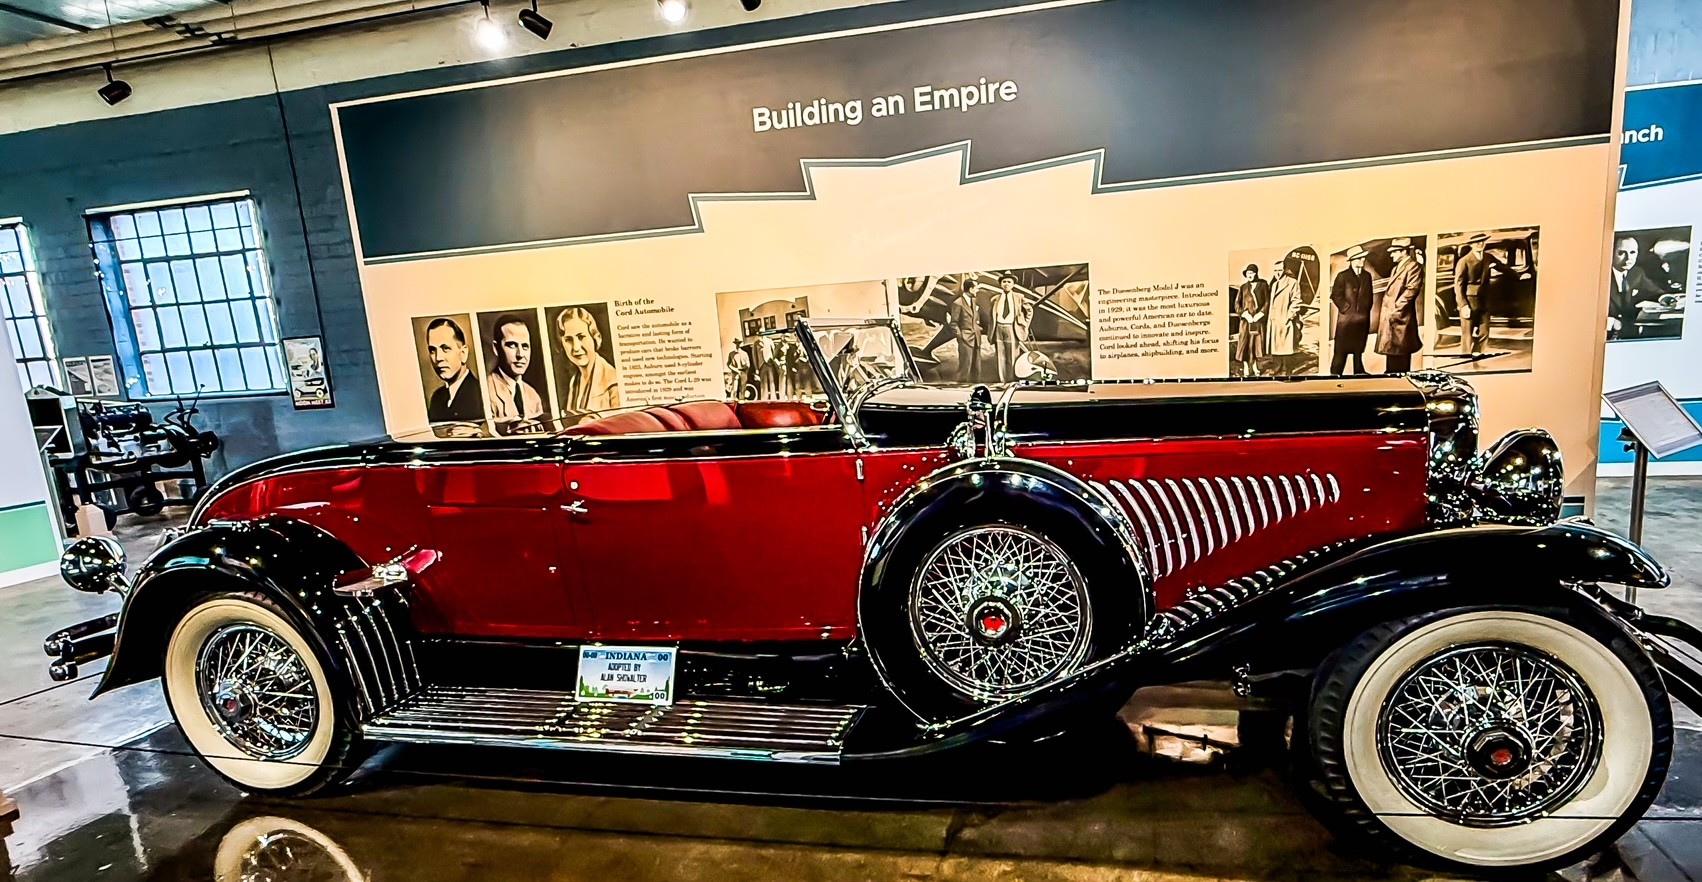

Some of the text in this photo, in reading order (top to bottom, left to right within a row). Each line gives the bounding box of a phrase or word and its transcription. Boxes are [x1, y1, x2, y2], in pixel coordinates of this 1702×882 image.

[752, 77, 1018, 132] Building an Empire
[1098, 296, 1136, 305] engineering
[1182, 290, 1218, 298] Introduced
[634, 306, 674, 315] Automobile
[1112, 314, 1141, 323] powerful
[1108, 351, 1139, 359] airplanes,
[1142, 349, 1184, 357] shipbuilding,
[605, 652, 647, 660] INDIANA
[608, 663, 631, 671] ADOPTED
[617, 674, 647, 682] SHOWALTER
